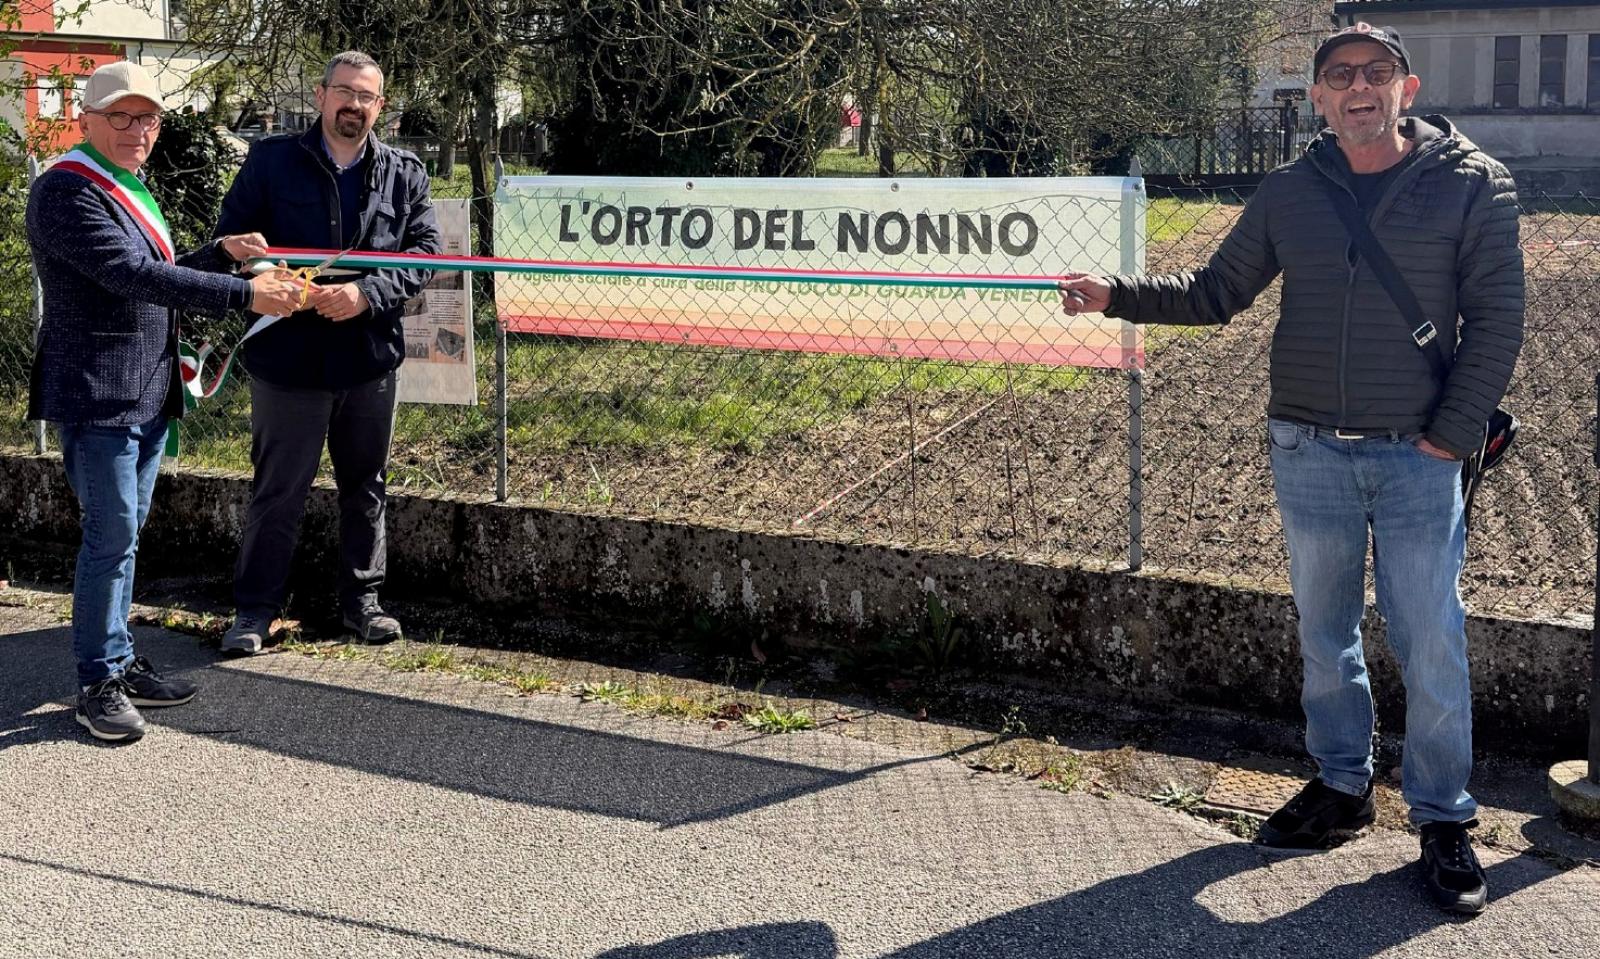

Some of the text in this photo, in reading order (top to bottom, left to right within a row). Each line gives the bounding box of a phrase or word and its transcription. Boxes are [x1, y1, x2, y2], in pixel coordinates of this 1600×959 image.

[559, 202, 1038, 257] L'ORTO DEL NONNO
[577, 274, 631, 286] sociale
[636, 276, 647, 287] a
[652, 278, 688, 289] cura
[695, 279, 736, 292] della
[744, 280, 781, 295] PRO
[788, 282, 843, 297] LOCO
[849, 284, 869, 297] DI
[877, 285, 967, 300] GUARDA
[975, 287, 1059, 303] VENETA
